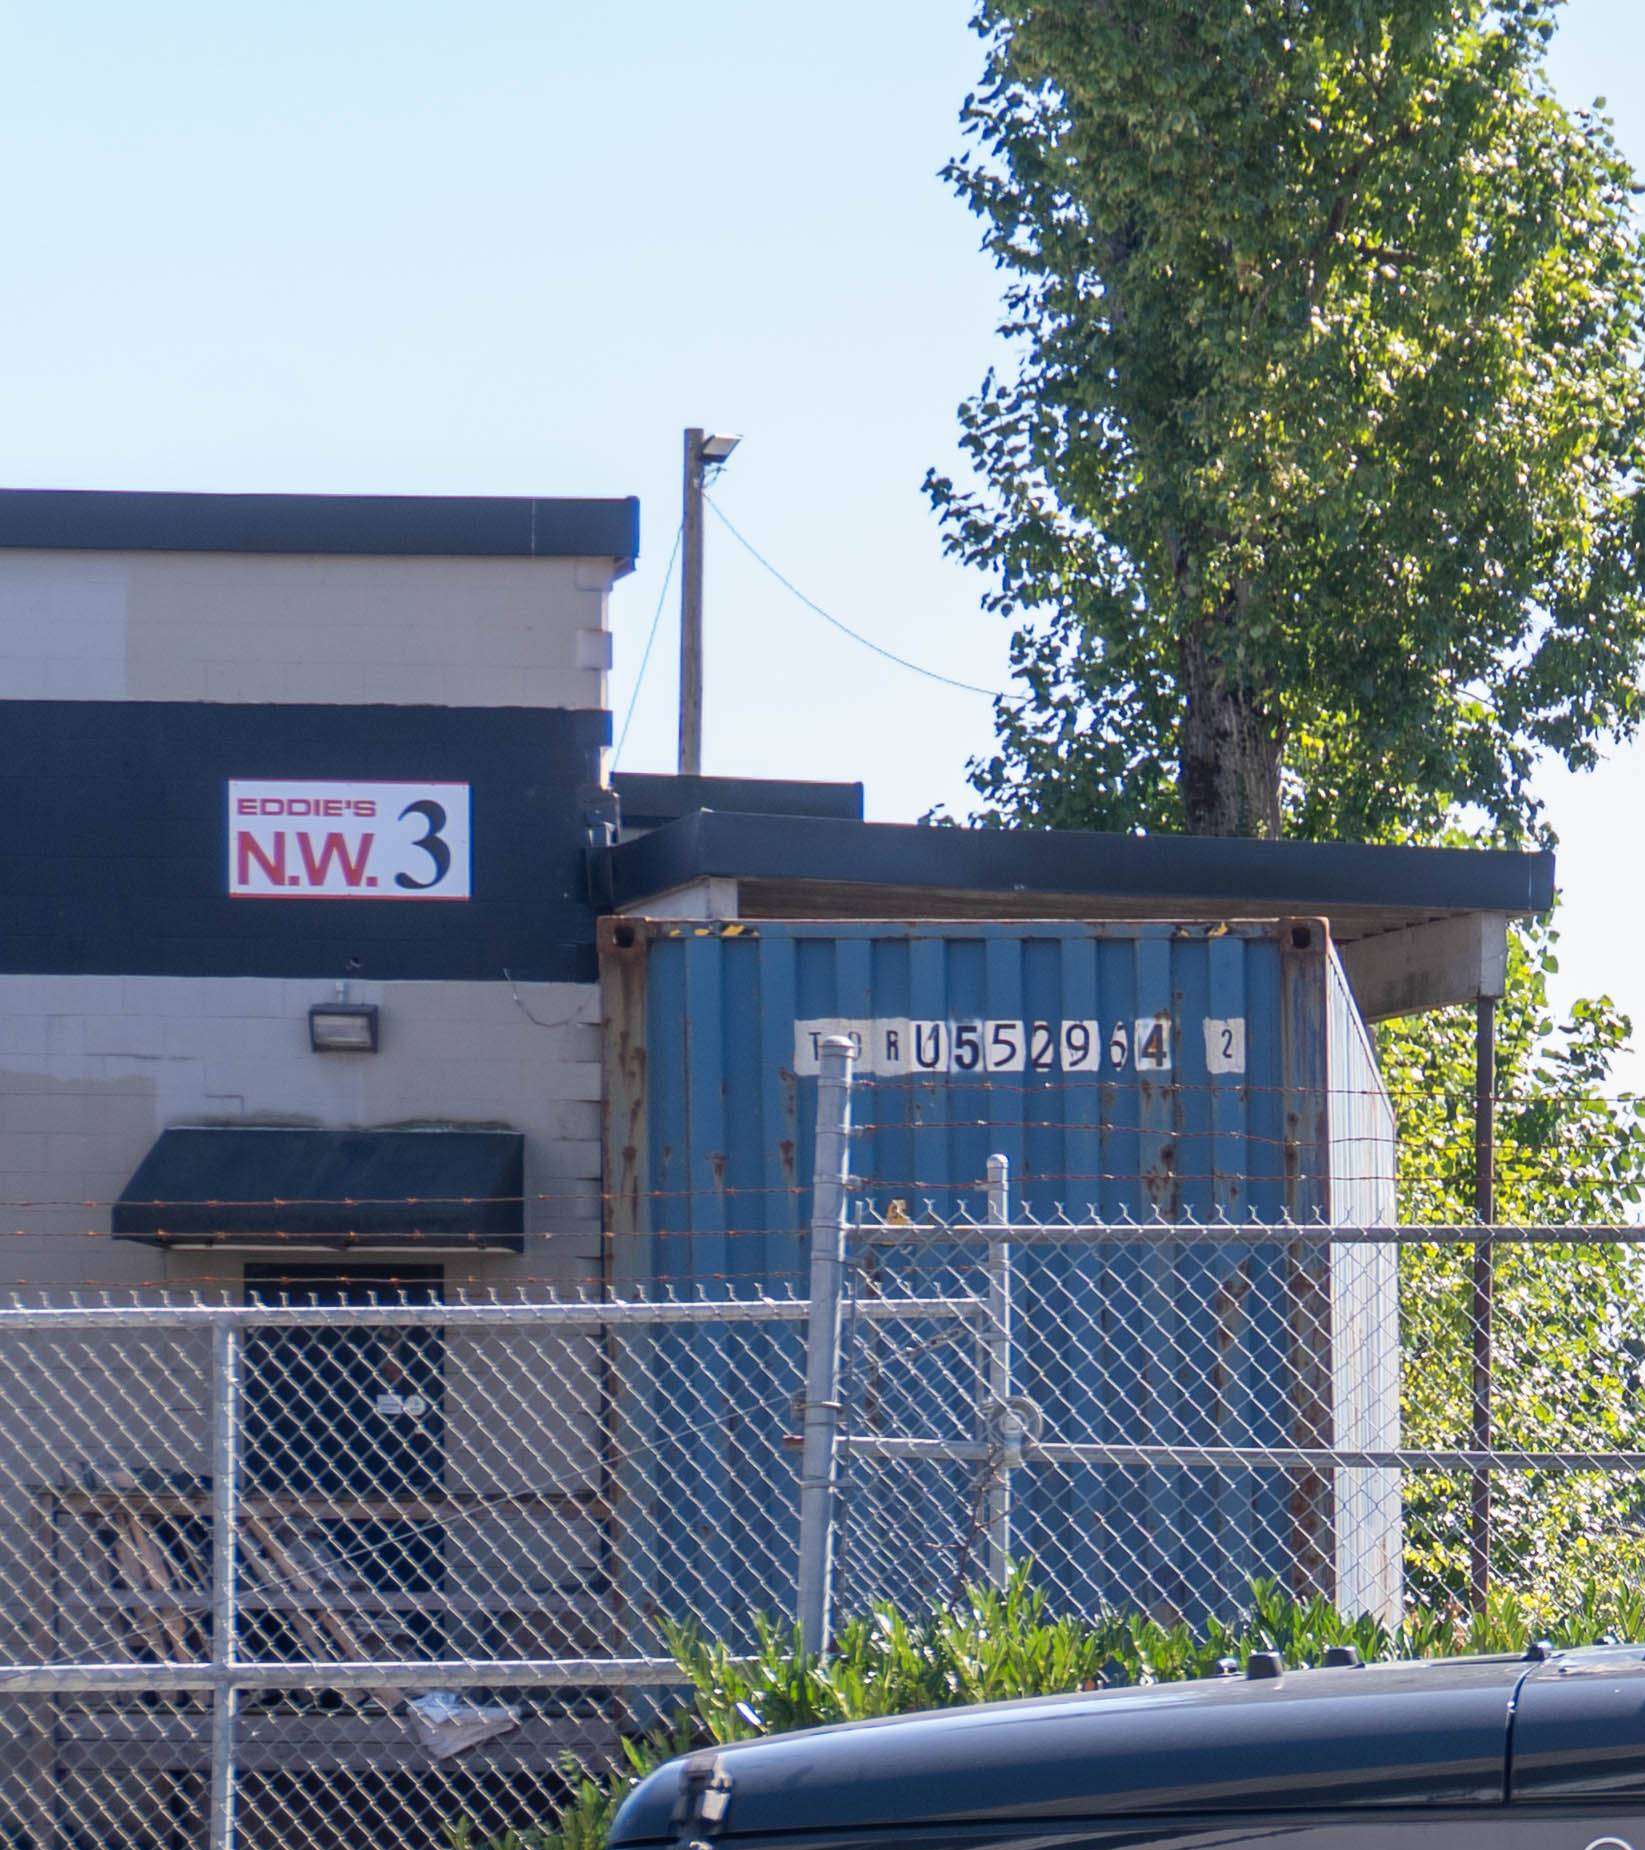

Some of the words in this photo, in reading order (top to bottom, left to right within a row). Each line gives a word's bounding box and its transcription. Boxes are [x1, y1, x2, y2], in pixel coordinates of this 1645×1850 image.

[236, 798, 377, 817] EDDIE'S
[236, 831, 379, 887] N.W.
[394, 799, 451, 889] 3
[1220, 1028, 1233, 1059] 2
